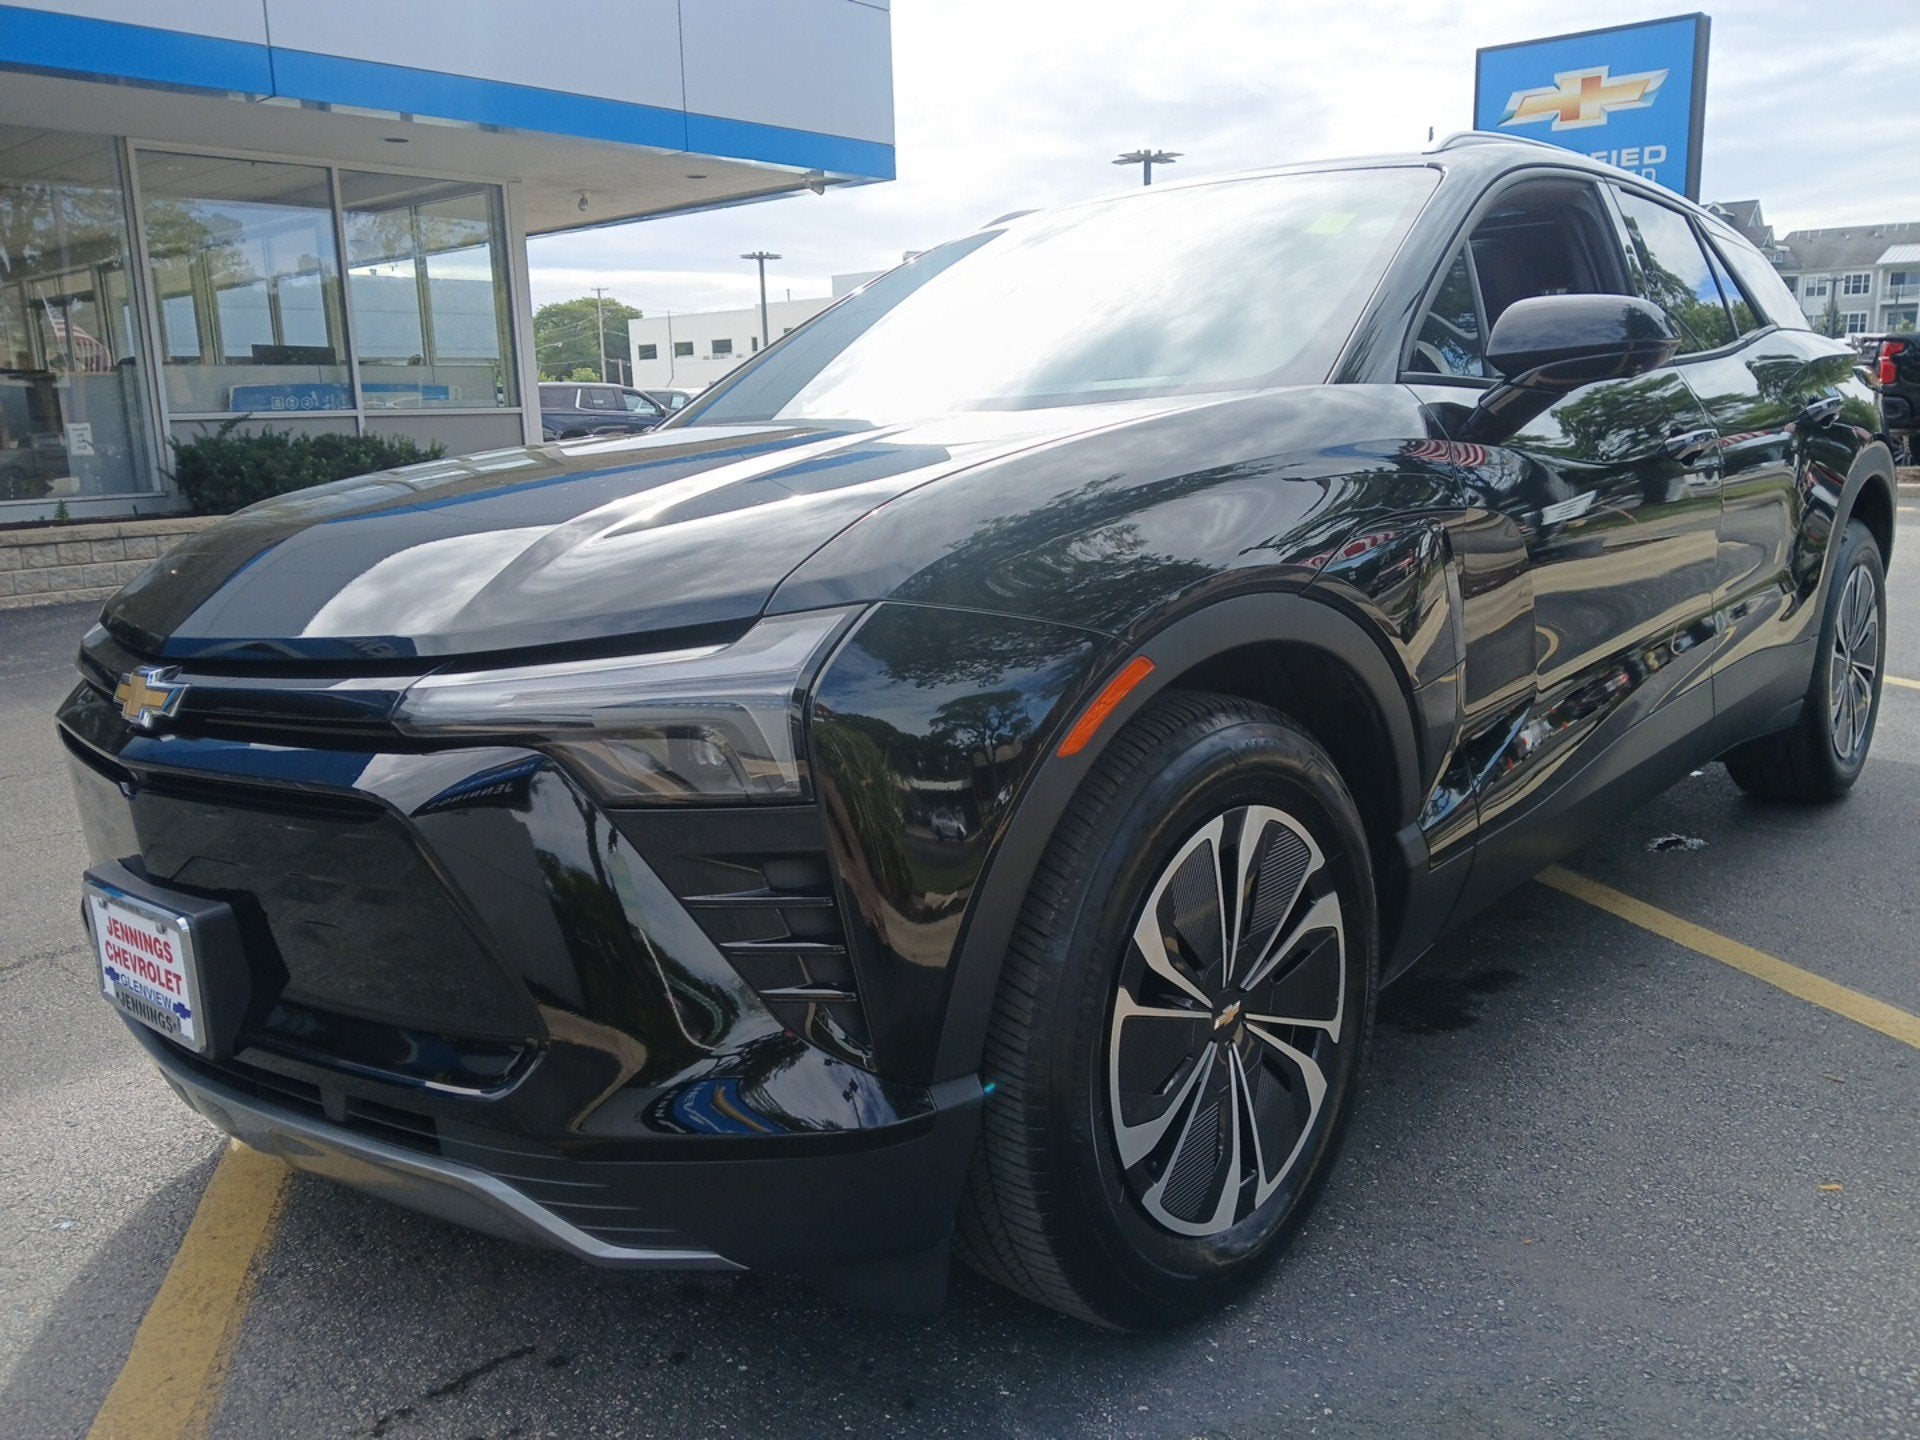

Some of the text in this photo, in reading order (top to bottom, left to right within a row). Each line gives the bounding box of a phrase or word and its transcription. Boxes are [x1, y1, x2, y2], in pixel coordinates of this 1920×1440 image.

[1585, 144, 1668, 168] FIED
[106, 916, 173, 964] JENNINGS
[105, 940, 182, 996] CHEVROLET
[120, 973, 173, 1009] GLENVIEW
[119, 993, 173, 1033] JENNINGS
